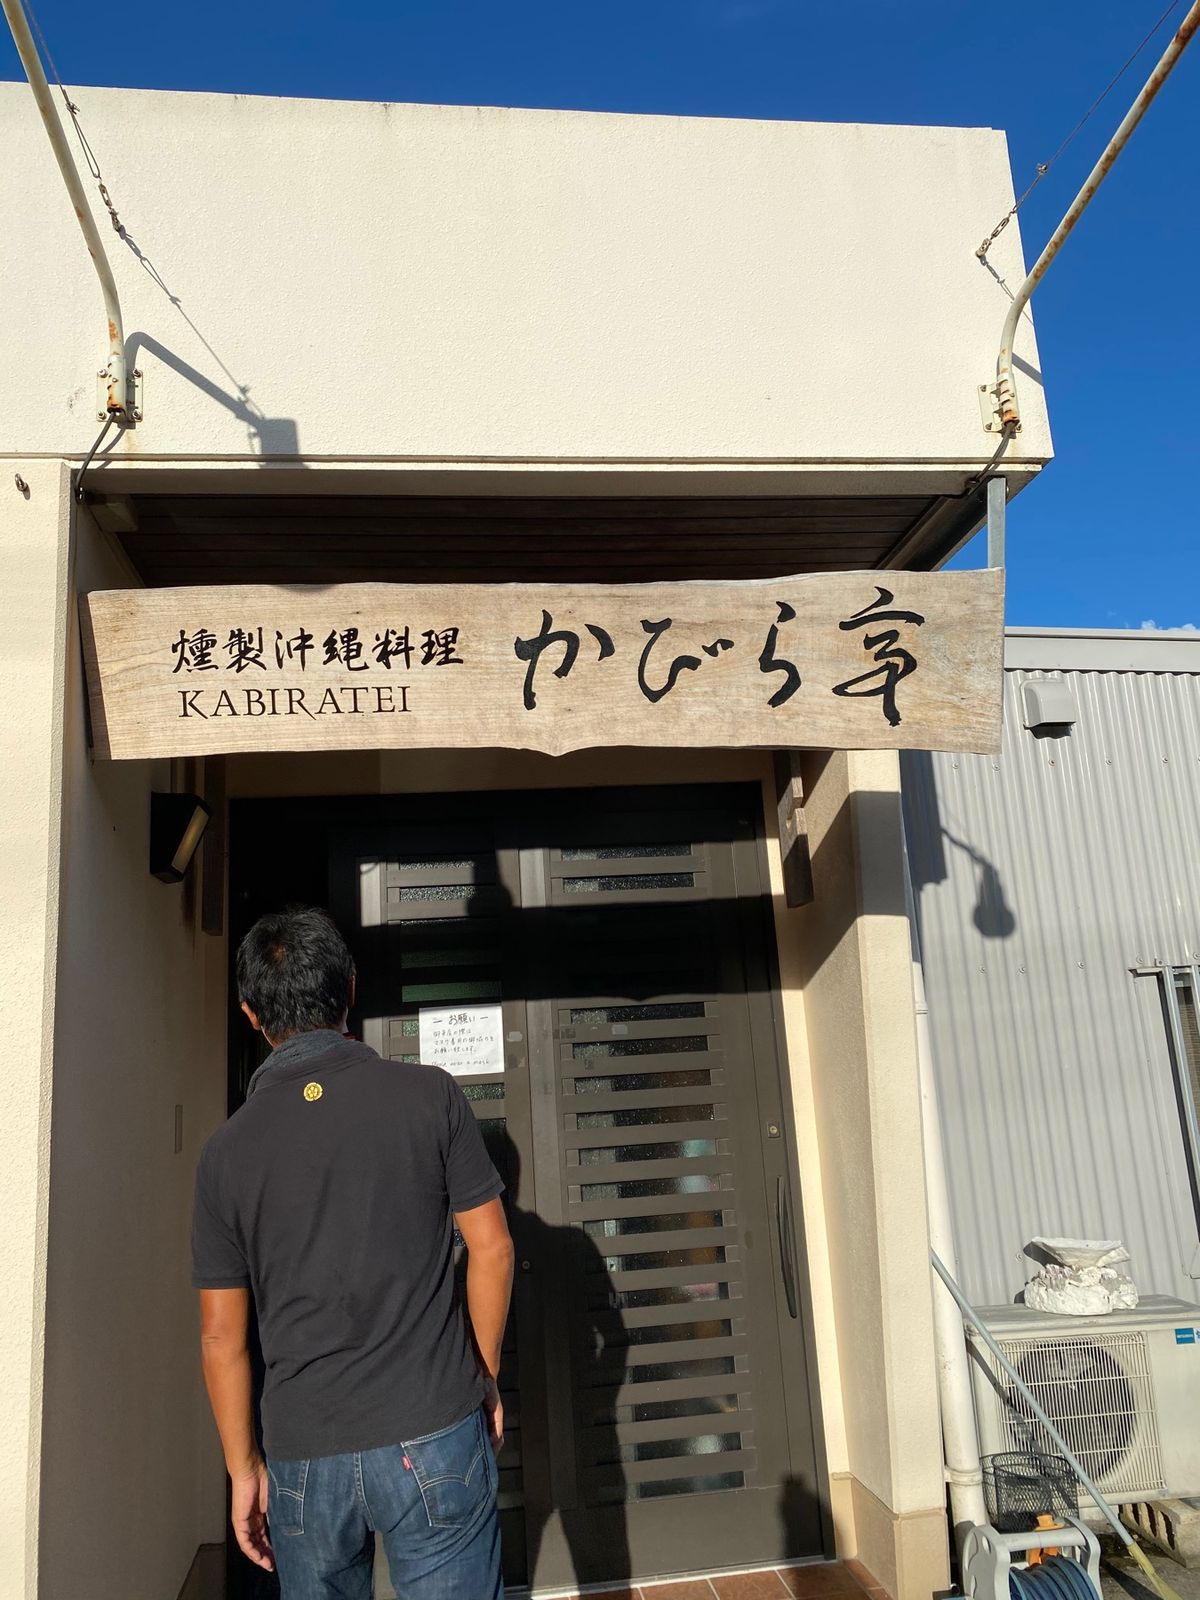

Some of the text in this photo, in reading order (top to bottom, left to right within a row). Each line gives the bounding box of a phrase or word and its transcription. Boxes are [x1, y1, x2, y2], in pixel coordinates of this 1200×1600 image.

[171, 625, 464, 674] 燻製沖縄料理
[514, 586, 925, 728] かびら亭
[177, 685, 412, 721] KABIRATEI
